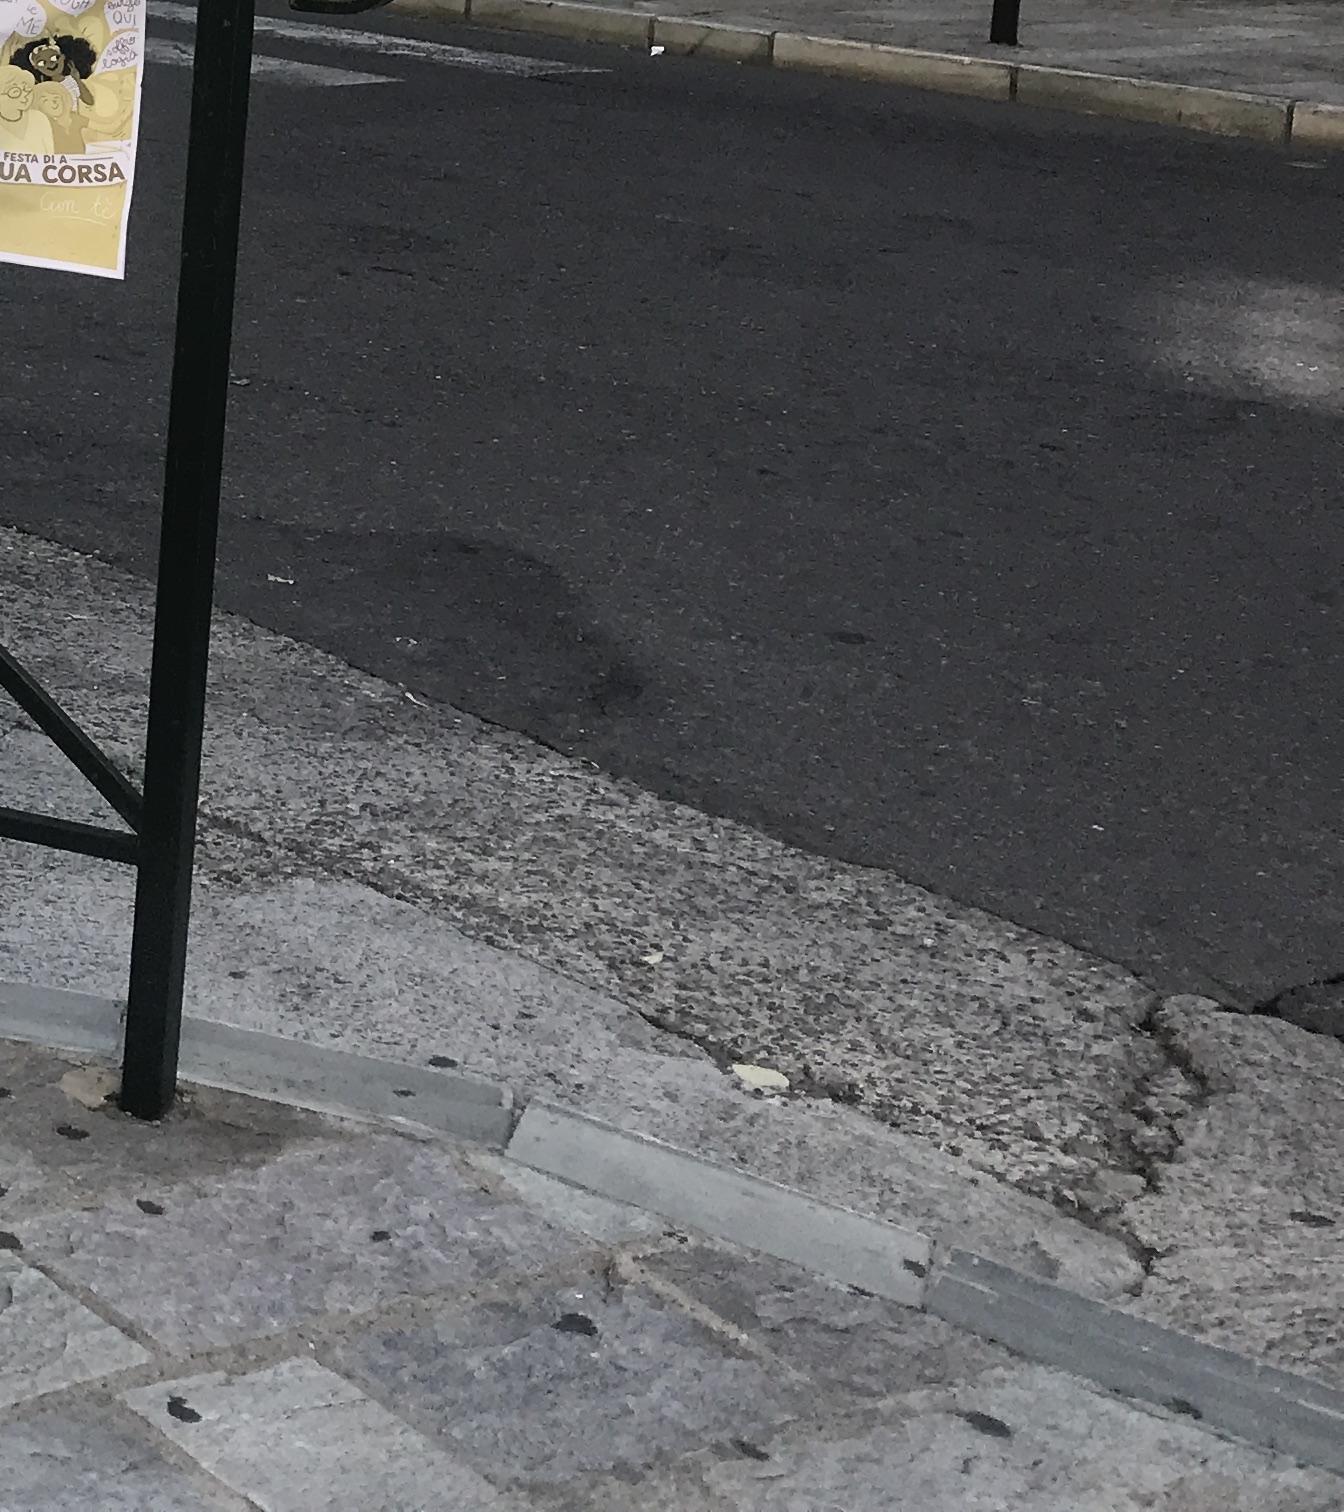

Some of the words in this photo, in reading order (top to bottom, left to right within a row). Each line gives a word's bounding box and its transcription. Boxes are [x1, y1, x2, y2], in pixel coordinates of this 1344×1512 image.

[3, 151, 39, 164] FESTA
[42, 152, 56, 164] DI
[59, 154, 68, 165] A
[41, 162, 127, 185] CORSA
